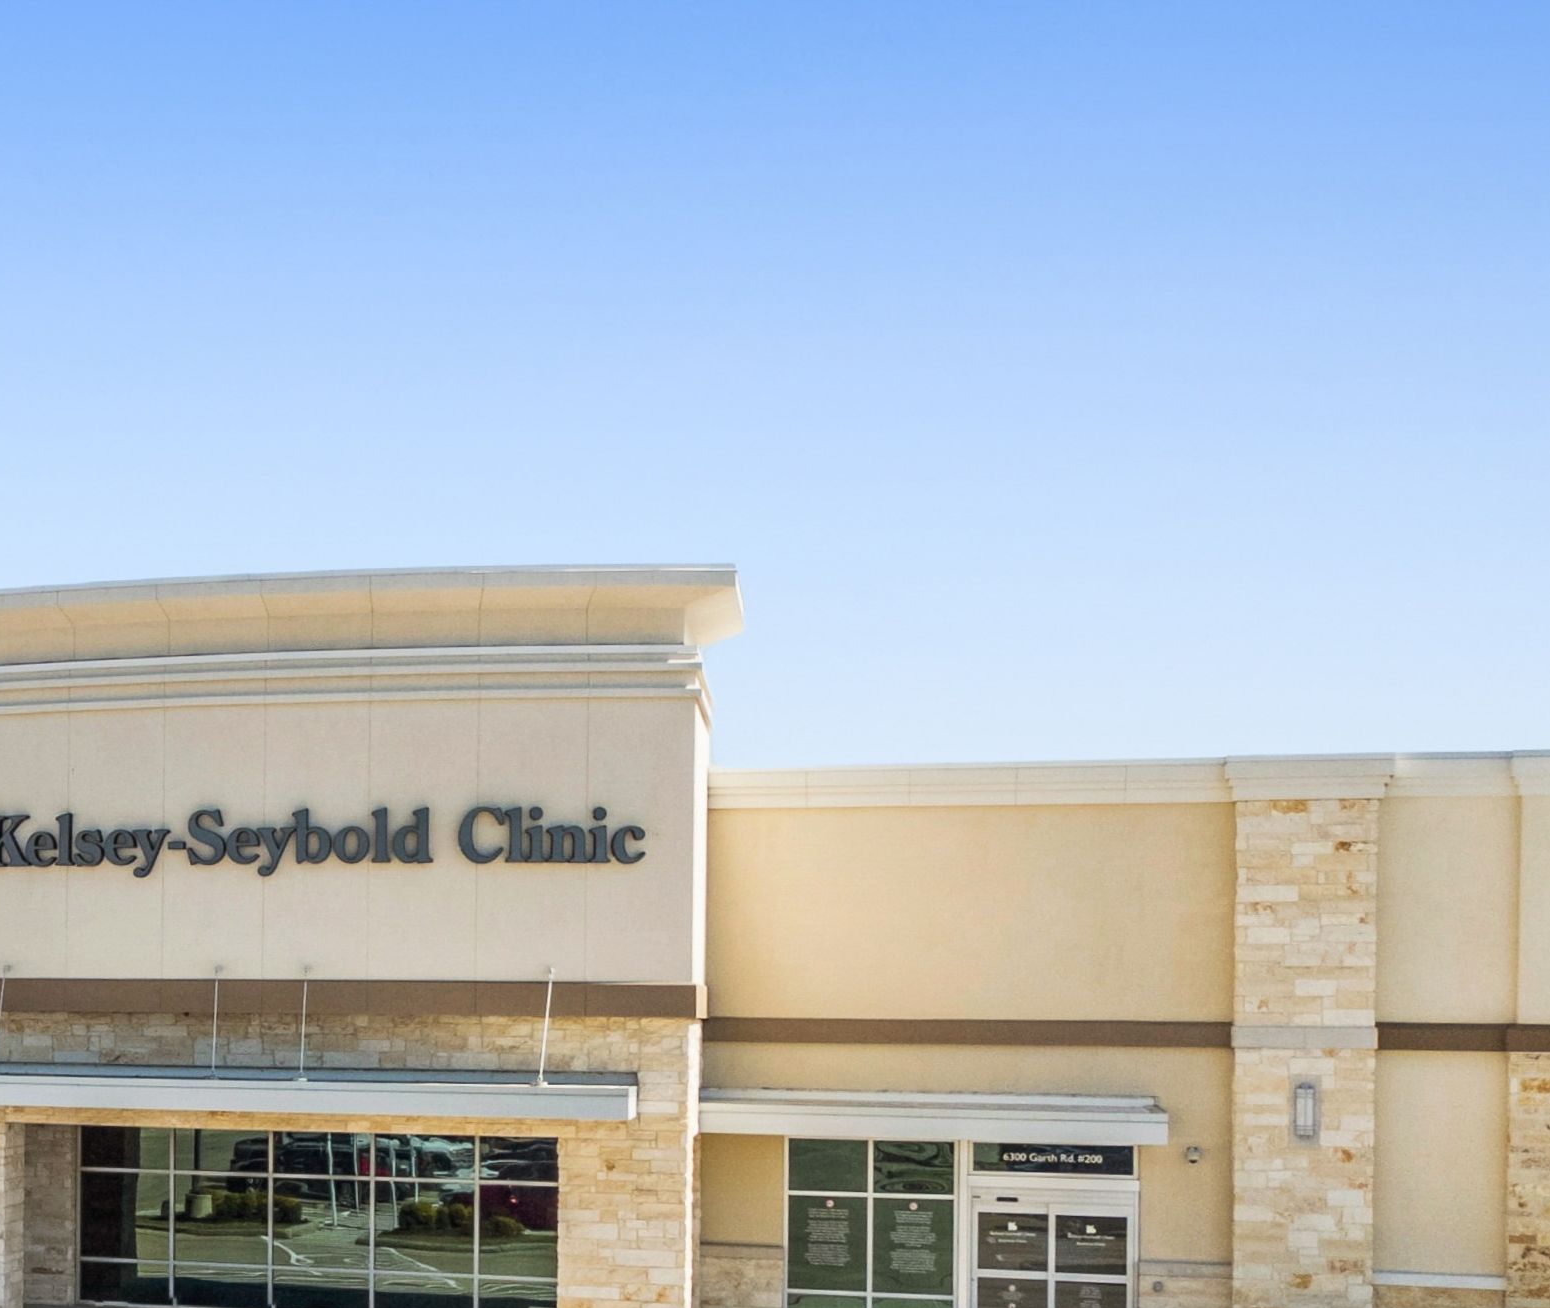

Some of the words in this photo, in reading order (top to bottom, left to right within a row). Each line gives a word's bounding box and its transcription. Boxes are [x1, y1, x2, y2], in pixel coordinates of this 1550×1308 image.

[458, 806, 647, 865] Clinic
[1002, 1152, 1027, 1162] 6300
[1028, 1152, 1058, 1163] Garth
[1077, 1154, 1103, 1164] #200
